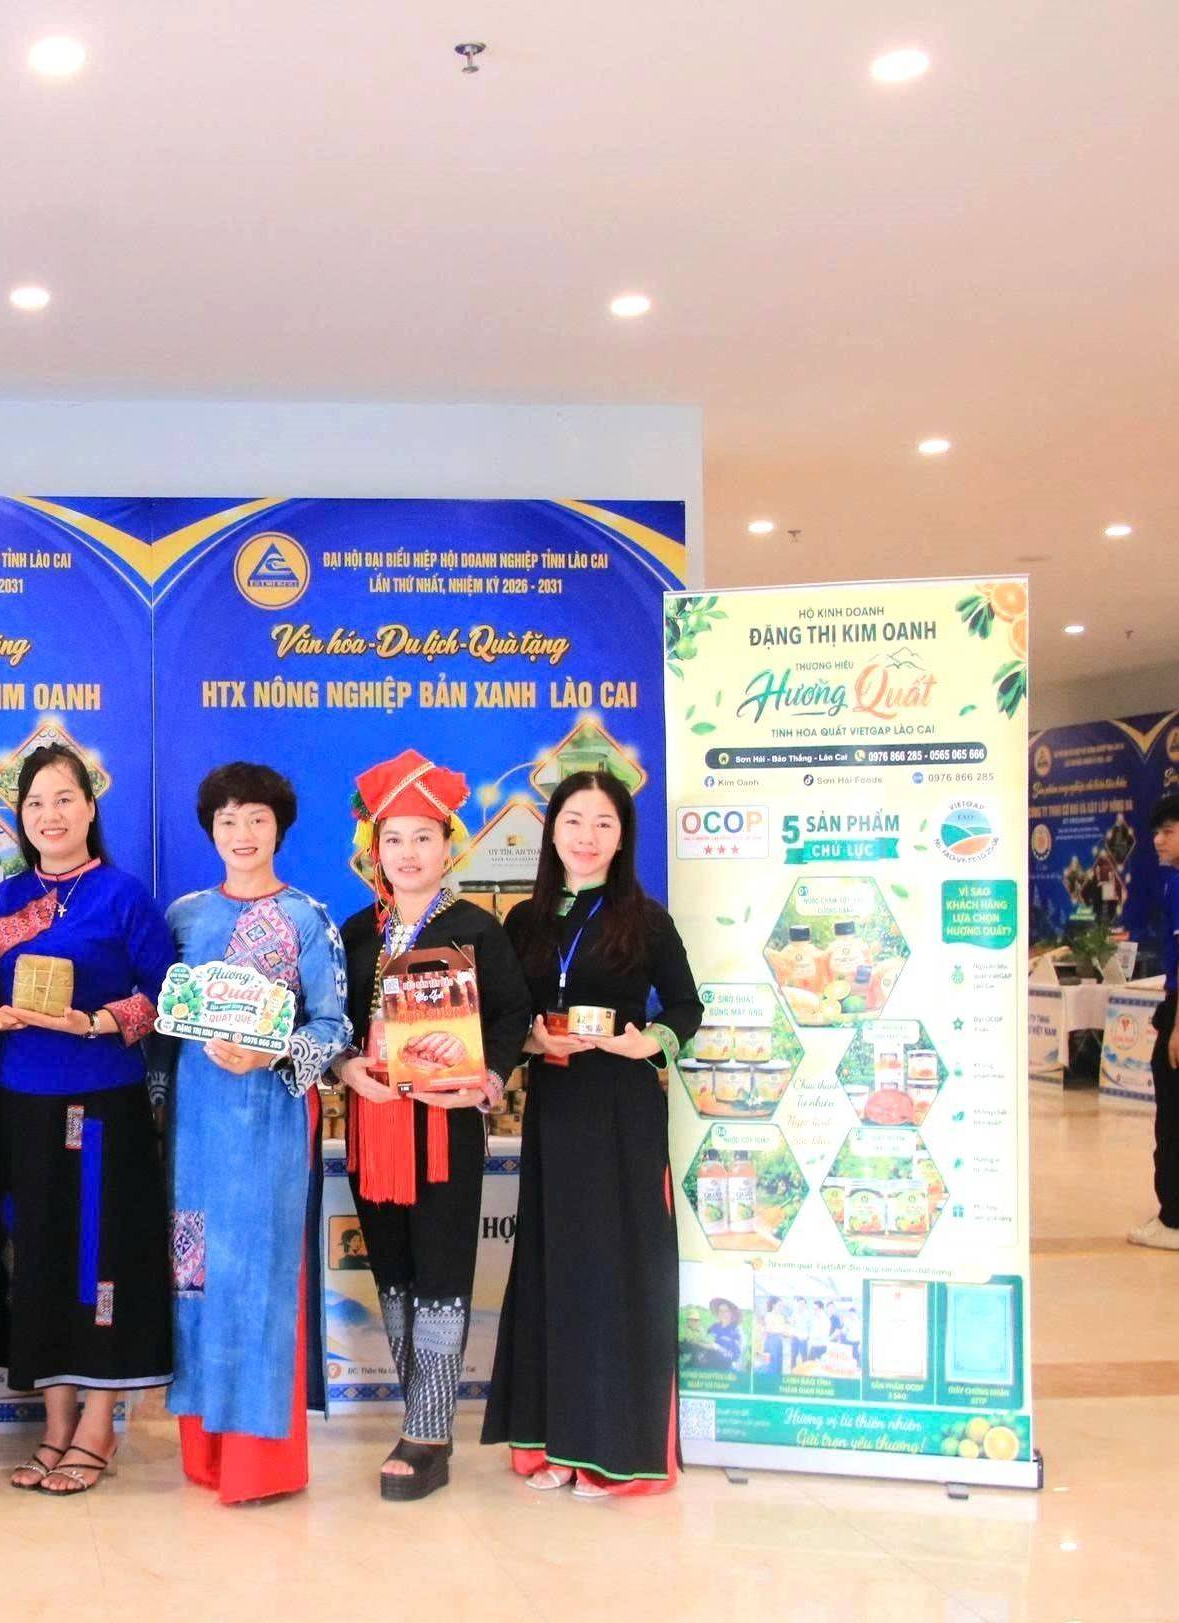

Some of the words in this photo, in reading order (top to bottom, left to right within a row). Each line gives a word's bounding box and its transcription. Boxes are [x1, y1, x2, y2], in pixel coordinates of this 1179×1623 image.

[2, 547, 27, 568] TỈNH
[29, 550, 50, 569] LÀO
[53, 552, 72, 569] CAI
[323, 551, 341, 570] ĐẠI
[344, 549, 362, 570] HỘI
[365, 551, 383, 570] ĐẠI
[386, 547, 410, 567] BIỂU
[413, 549, 437, 571] HIỆP
[440, 549, 458, 570] HỘI
[461, 553, 497, 568] DOANH
[500, 551, 538, 571] NGHIỆP
[541, 548, 565, 569] TỈNH
[568, 551, 588, 569] LÀO
[591, 553, 608, 569] CAI
[817, 607, 843, 618] KINH
[846, 606, 884, 617] DOANH
[748, 624, 802, 650] ĐẶNG
[806, 625, 836, 647] THỊ
[842, 623, 877, 643] KIM
[883, 620, 937, 641] OANH
[33, 683, 101, 711] OANH
[202, 681, 247, 708] HTX
[253, 676, 319, 708] NÔNG
[326, 676, 412, 713] NGHIỆP
[419, 673, 467, 708] BẢN
[474, 682, 536, 708] XANH
[550, 675, 593, 708] LÀO
[600, 681, 637, 708] CAI
[852, 664, 939, 720] Quất
[928, 774, 952, 782] 0976
[955, 773, 973, 782] 866
[976, 772, 994, 781] 285
[682, 811, 762, 834] OCOP
[781, 815, 800, 844] 5
[806, 810, 841, 833] SẢN
[846, 809, 900, 832] PHẨM
[482, 1214, 516, 1244] HỢ
